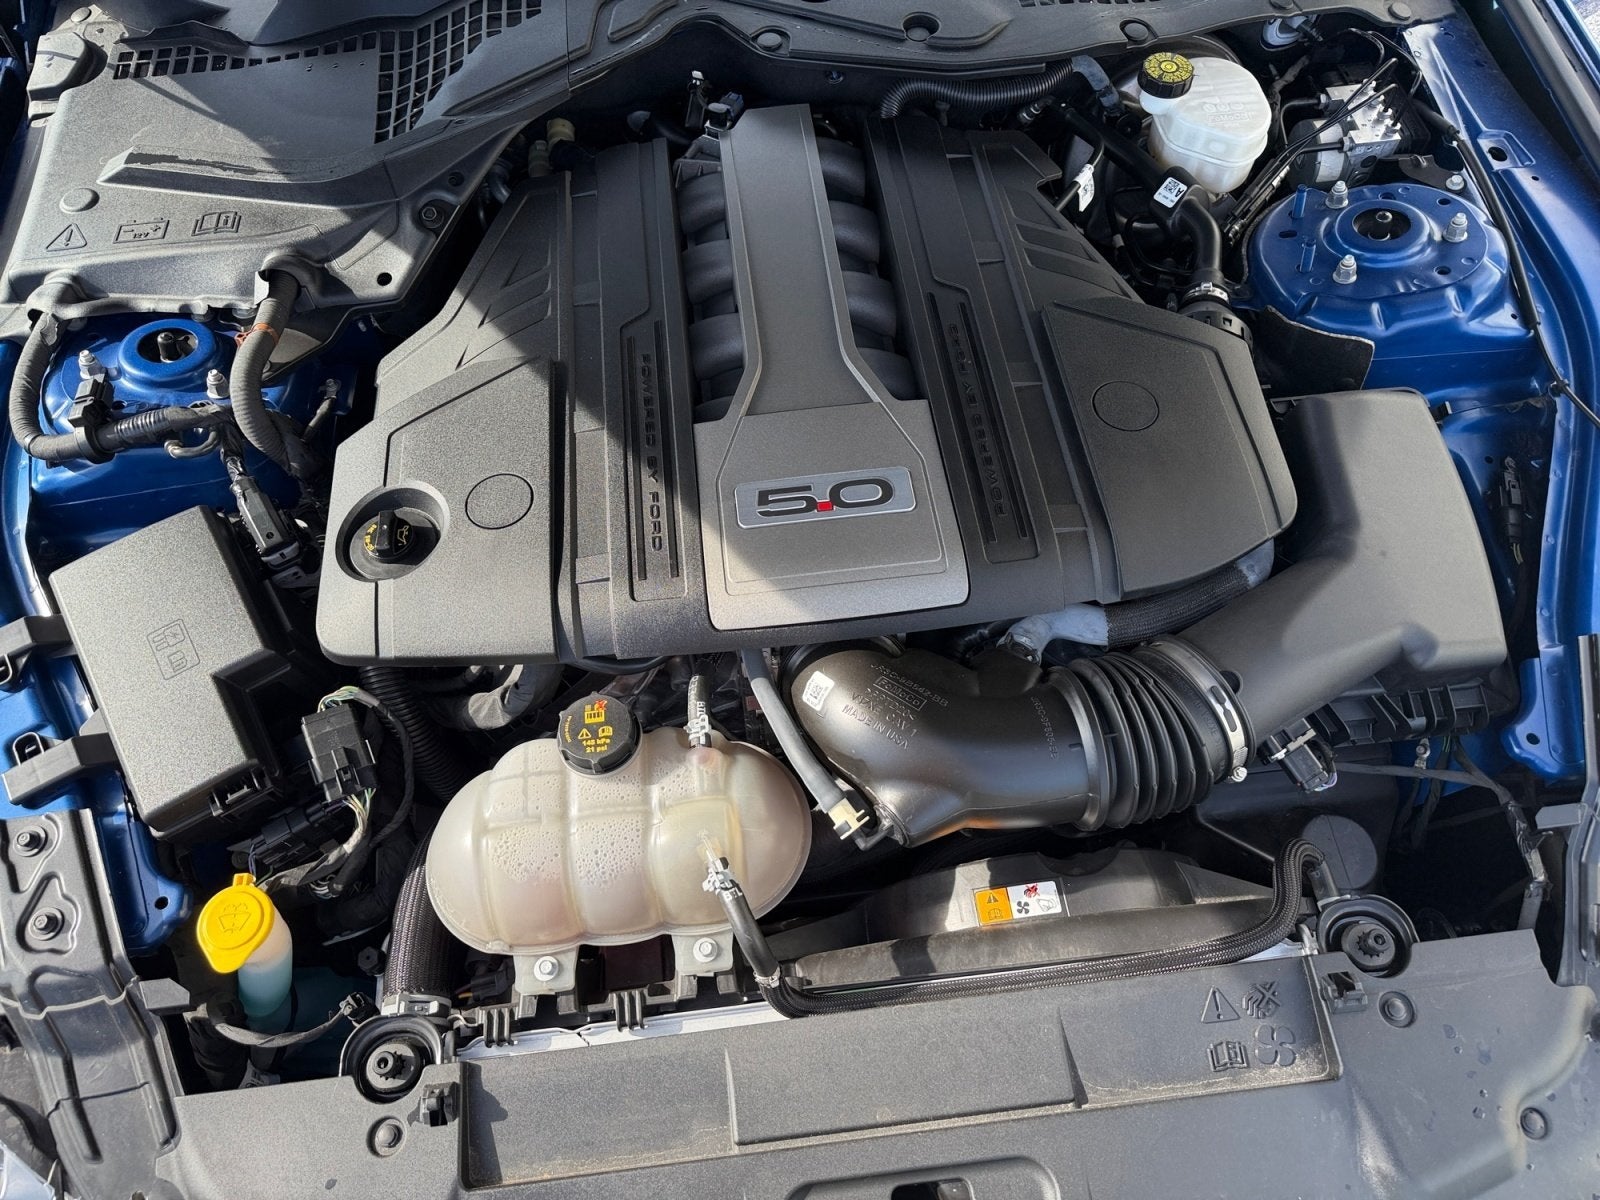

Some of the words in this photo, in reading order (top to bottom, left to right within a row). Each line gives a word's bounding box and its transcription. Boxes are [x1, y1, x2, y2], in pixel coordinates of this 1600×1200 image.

[641, 353, 656, 448] POWERED
[646, 455, 658, 483] BY
[756, 477, 894, 518] 5.0
[649, 491, 663, 551] FORD
[878, 679, 921, 706] FoMoCo
[841, 704, 872, 726] MADE
[873, 720, 886, 734] IN
[886, 730, 909, 749] USA
